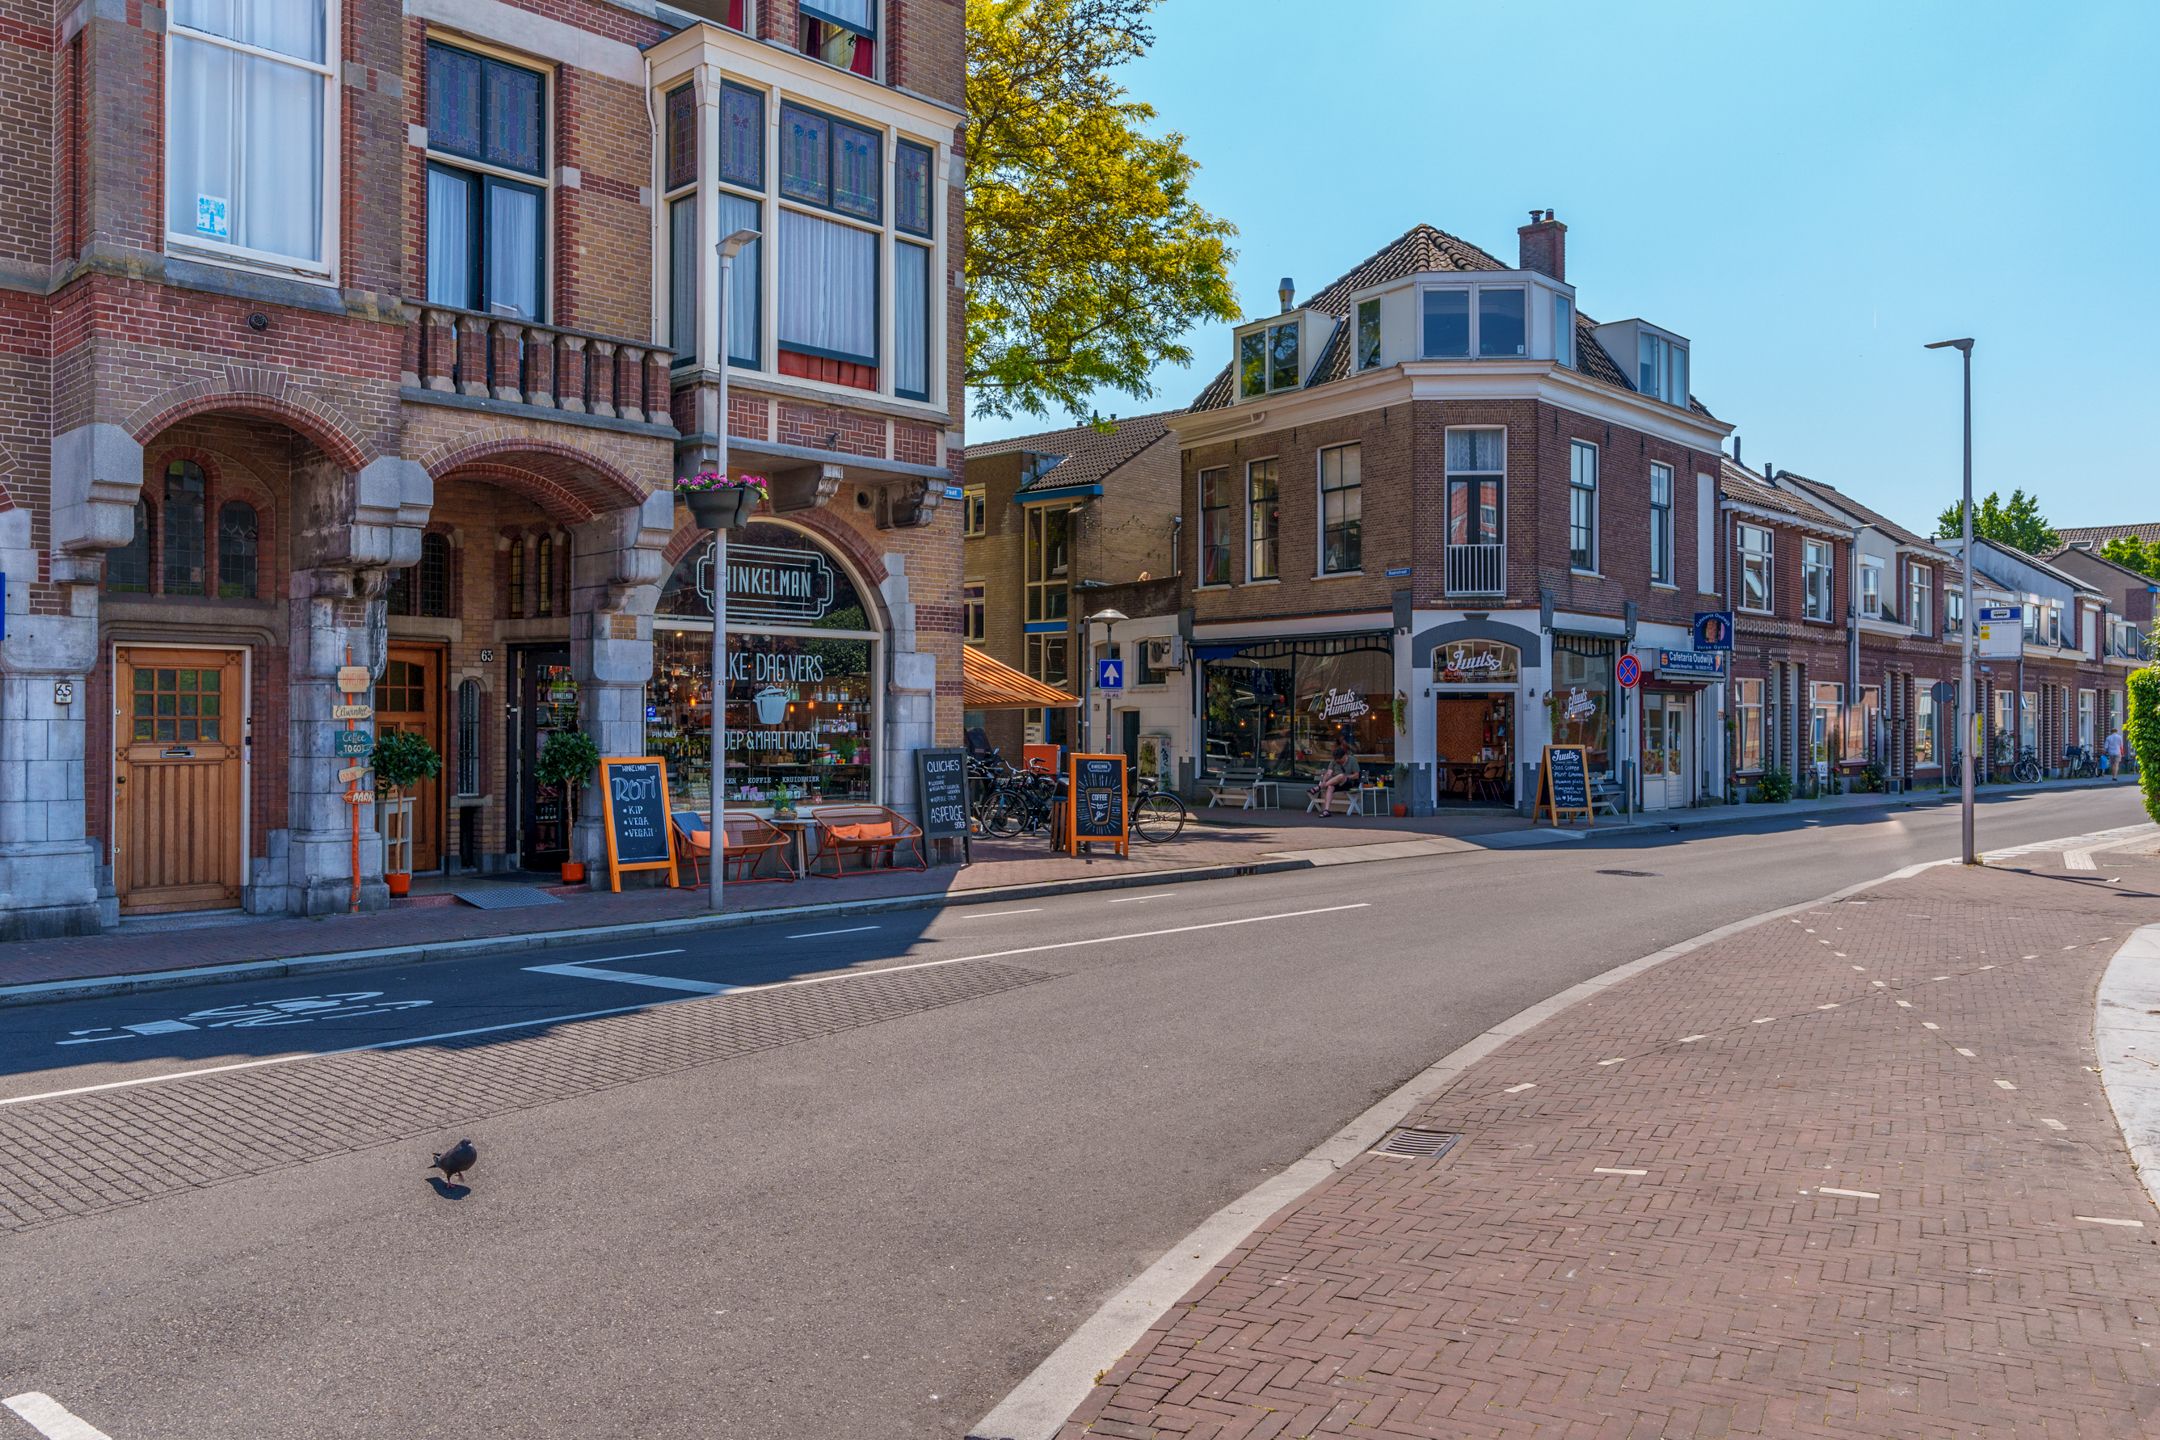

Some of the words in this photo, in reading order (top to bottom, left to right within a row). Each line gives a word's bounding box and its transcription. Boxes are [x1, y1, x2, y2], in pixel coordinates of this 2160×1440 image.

[481, 649, 493, 662] 63
[1693, 653, 1714, 666] Oudwijk
[756, 653, 785, 682] DAG
[789, 655, 824, 683] VERS
[56, 684, 72, 697] 65
[651, 730, 662, 738] PIN
[663, 730, 678, 739] ONLY
[724, 731, 745, 750] OEP
[755, 731, 819, 750] MAALTIJDEN
[927, 760, 960, 773] QUICHES
[1091, 793, 1108, 801] COFFEE
[628, 805, 644, 815] KIP
[628, 817, 649, 826] VEGA
